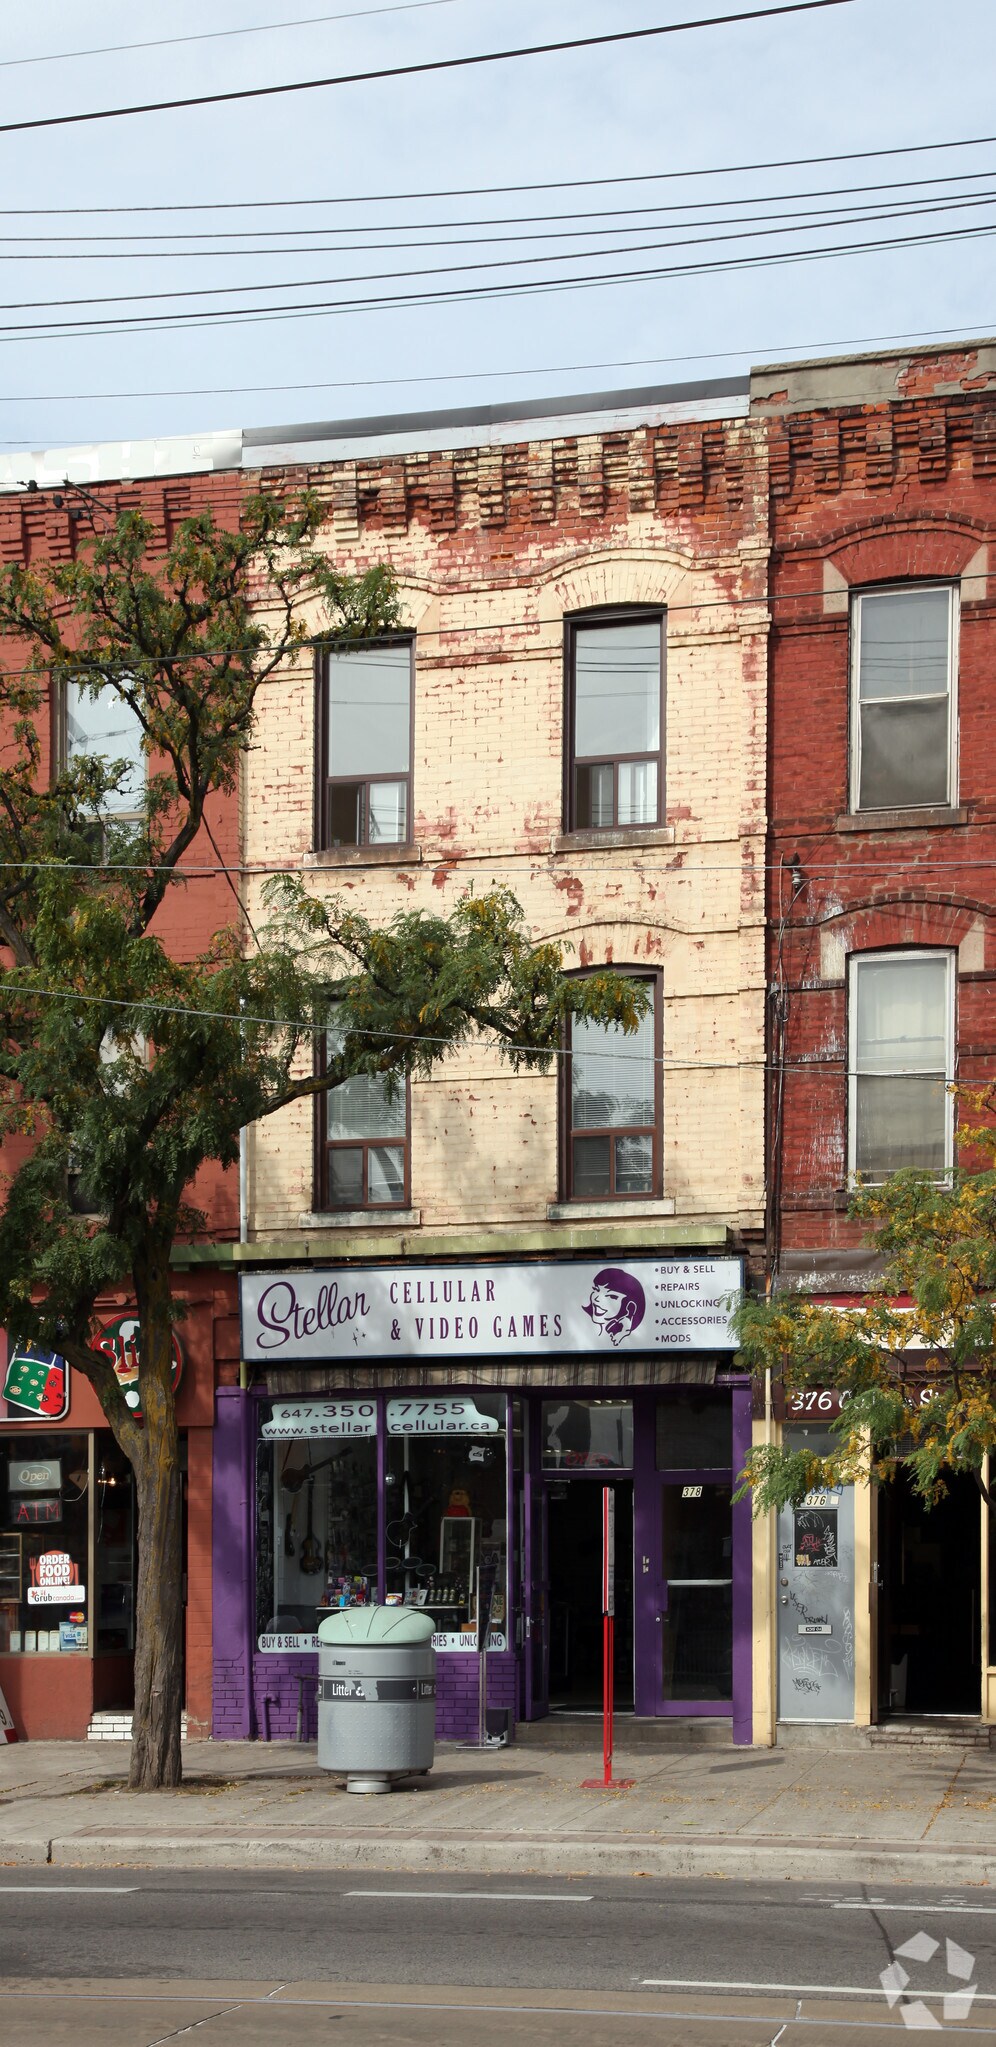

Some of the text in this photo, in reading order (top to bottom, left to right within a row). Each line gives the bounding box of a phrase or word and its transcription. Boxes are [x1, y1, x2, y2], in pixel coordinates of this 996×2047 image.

[660, 1264, 716, 1274] BUY & SELL
[660, 1282, 700, 1292] REPAIRS
[660, 1298, 720, 1309] UNLOCKING
[256, 1279, 496, 1349] Stellar CELLULAR
[660, 1315, 728, 1326] ACCESSORIES
[390, 1313, 563, 1341] & VIDEO GAMES
[660, 1333, 692, 1343] MODS
[791, 1391, 833, 1411] 376
[280, 1404, 374, 1419] 647.350
[390, 1418, 490, 1432] cellular.ca
[19, 1468, 51, 1483] Open
[683, 1487, 702, 1497] 378
[806, 1495, 827, 1506] 376
[17, 1501, 60, 1522] ATM
[39, 1554, 70, 1565] ORDER
[39, 1563, 71, 1578] FOOD
[39, 1575, 70, 1586] ONLINE!
[261, 1637, 277, 1649] BUY
[277, 1637, 283, 1648] &
[284, 1637, 300, 1648] SELL
[332, 1683, 353, 1696] Litter
